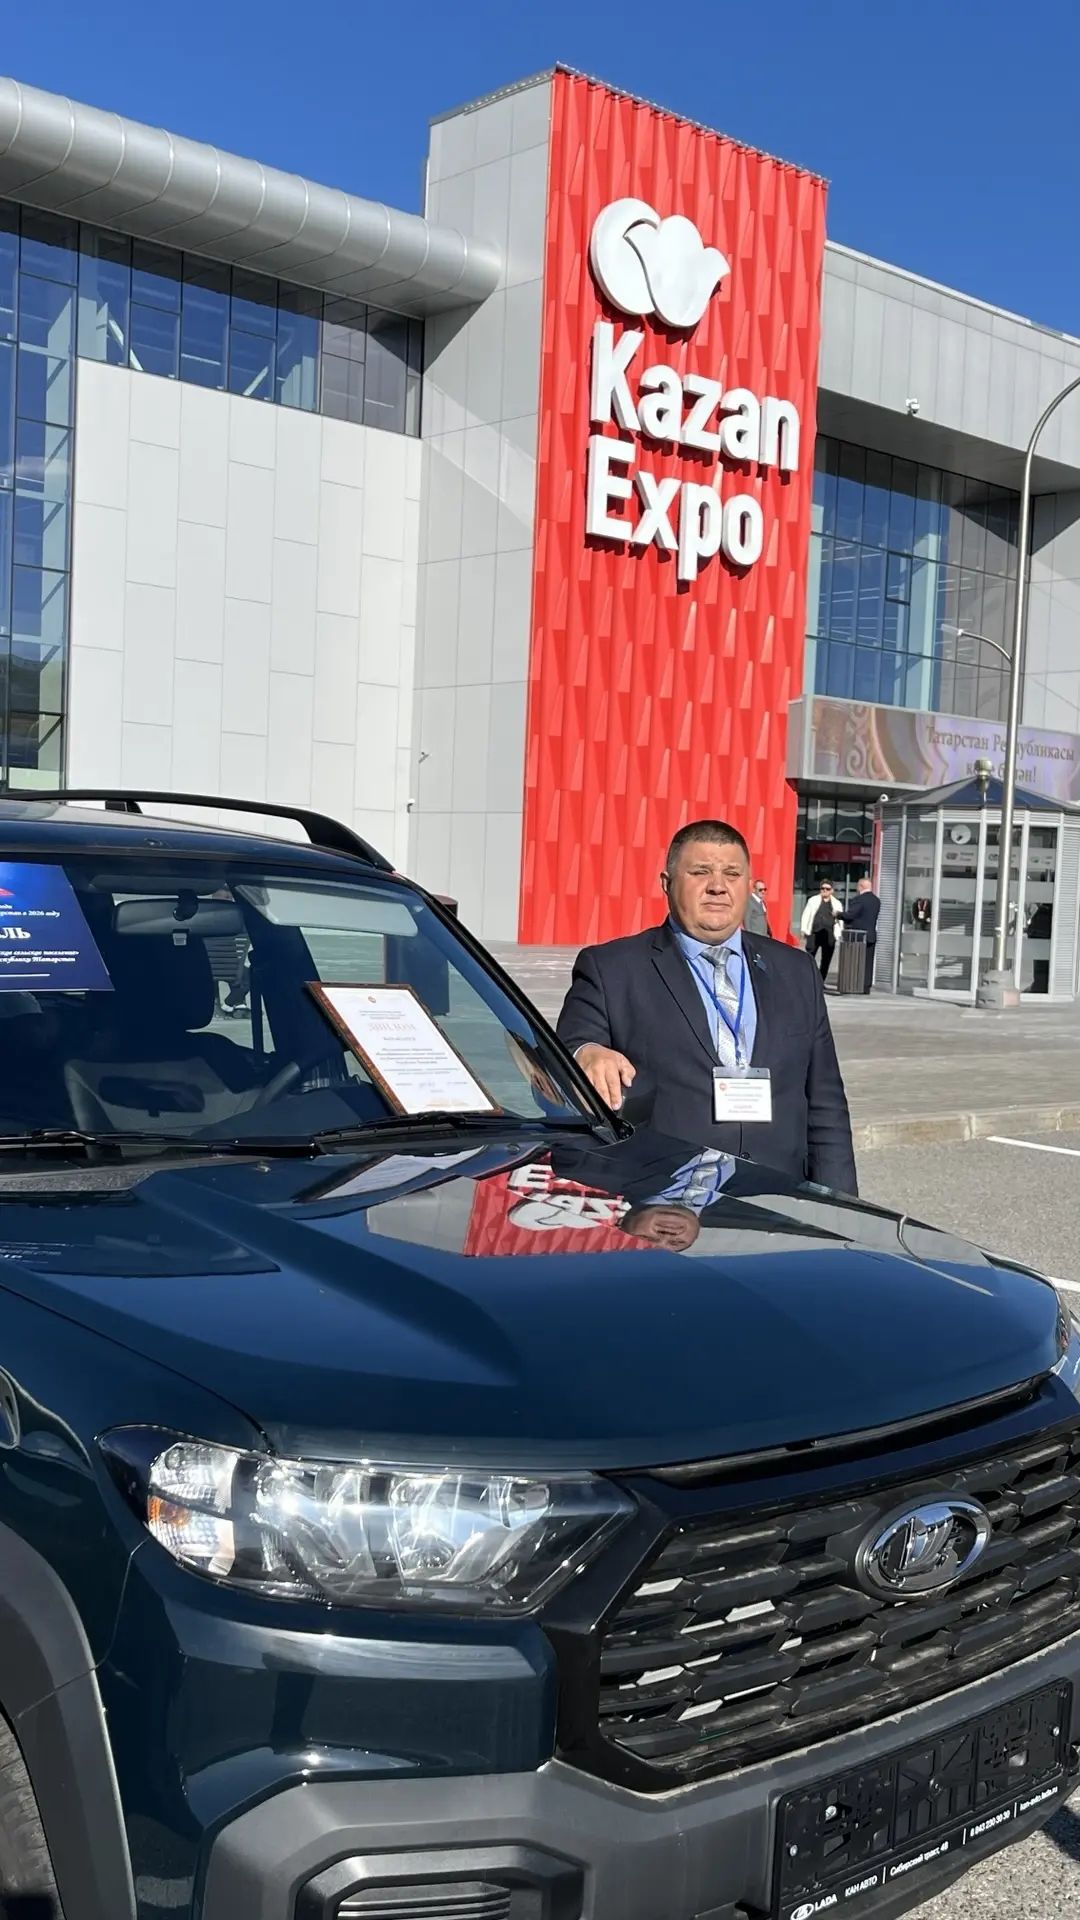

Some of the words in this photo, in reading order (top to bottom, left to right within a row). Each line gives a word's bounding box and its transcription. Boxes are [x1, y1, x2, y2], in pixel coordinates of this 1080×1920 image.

[590, 320, 800, 473] Kazan
[586, 434, 764, 582] Expo
[926, 726, 989, 752] Татарстан
[993, 734, 1074, 761] Реубликасы
[814, 1893, 838, 1912] LADA
